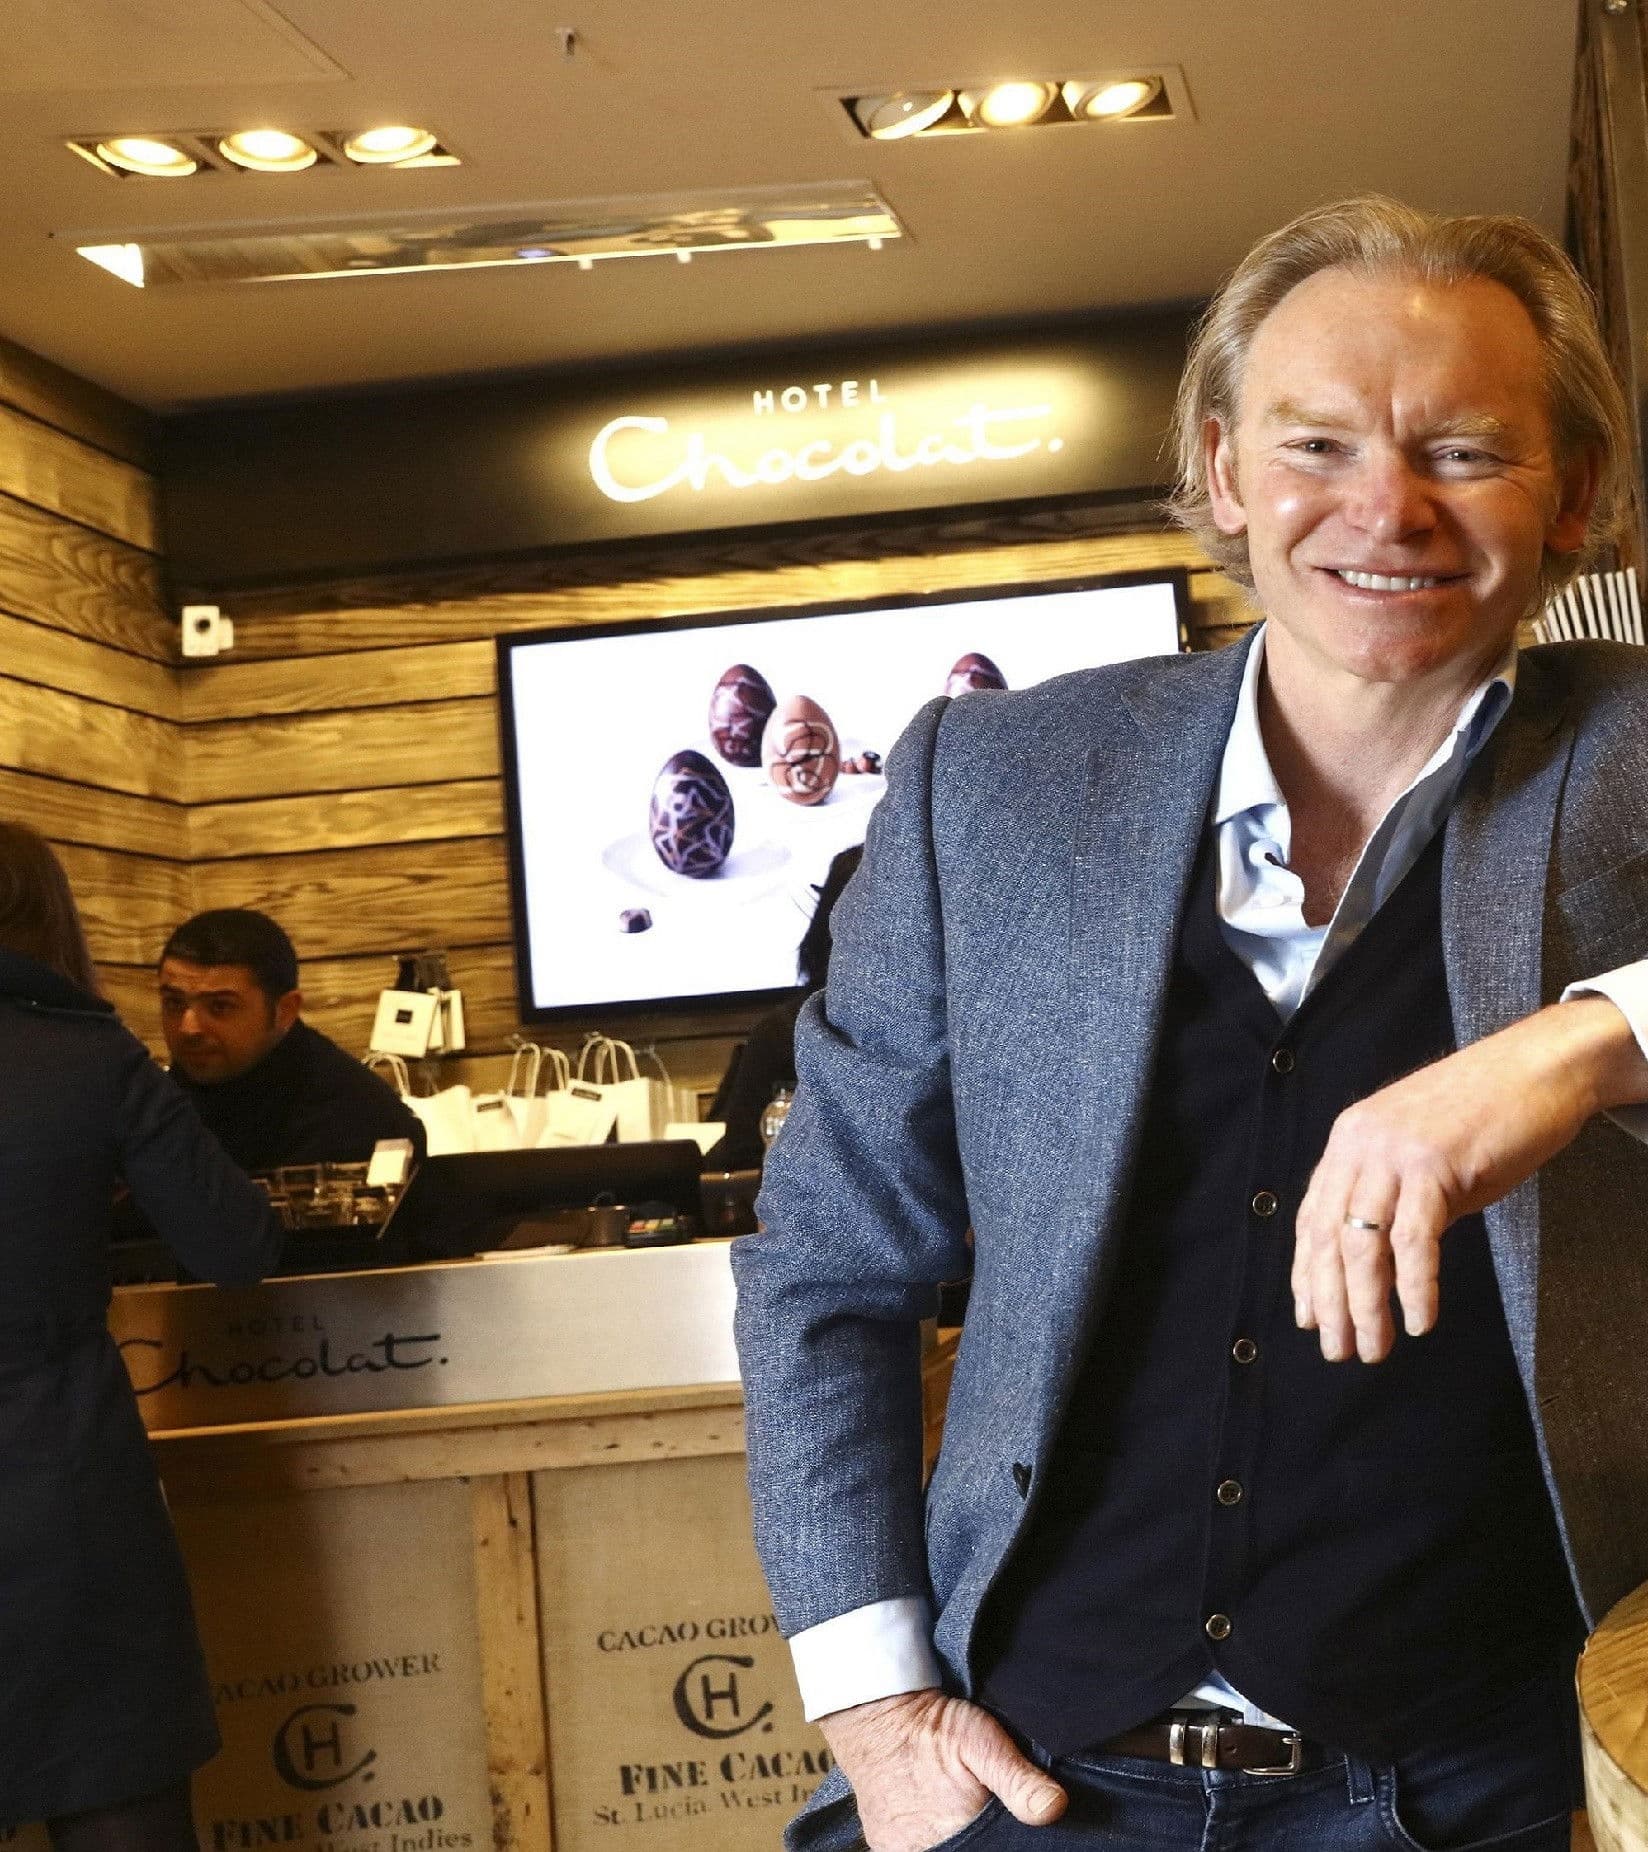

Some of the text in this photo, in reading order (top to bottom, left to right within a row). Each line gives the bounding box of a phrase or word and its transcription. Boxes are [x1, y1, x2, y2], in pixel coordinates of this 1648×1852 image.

[752, 379, 891, 417] HOTEL
[597, 1620, 700, 1652] CACAO
[212, 1652, 442, 1704] ACAO GROWER
[620, 1761, 709, 1796] FINE
[316, 1795, 444, 1835] CACAO
[720, 1789, 782, 1810] West
[390, 1829, 473, 1852] Indies
